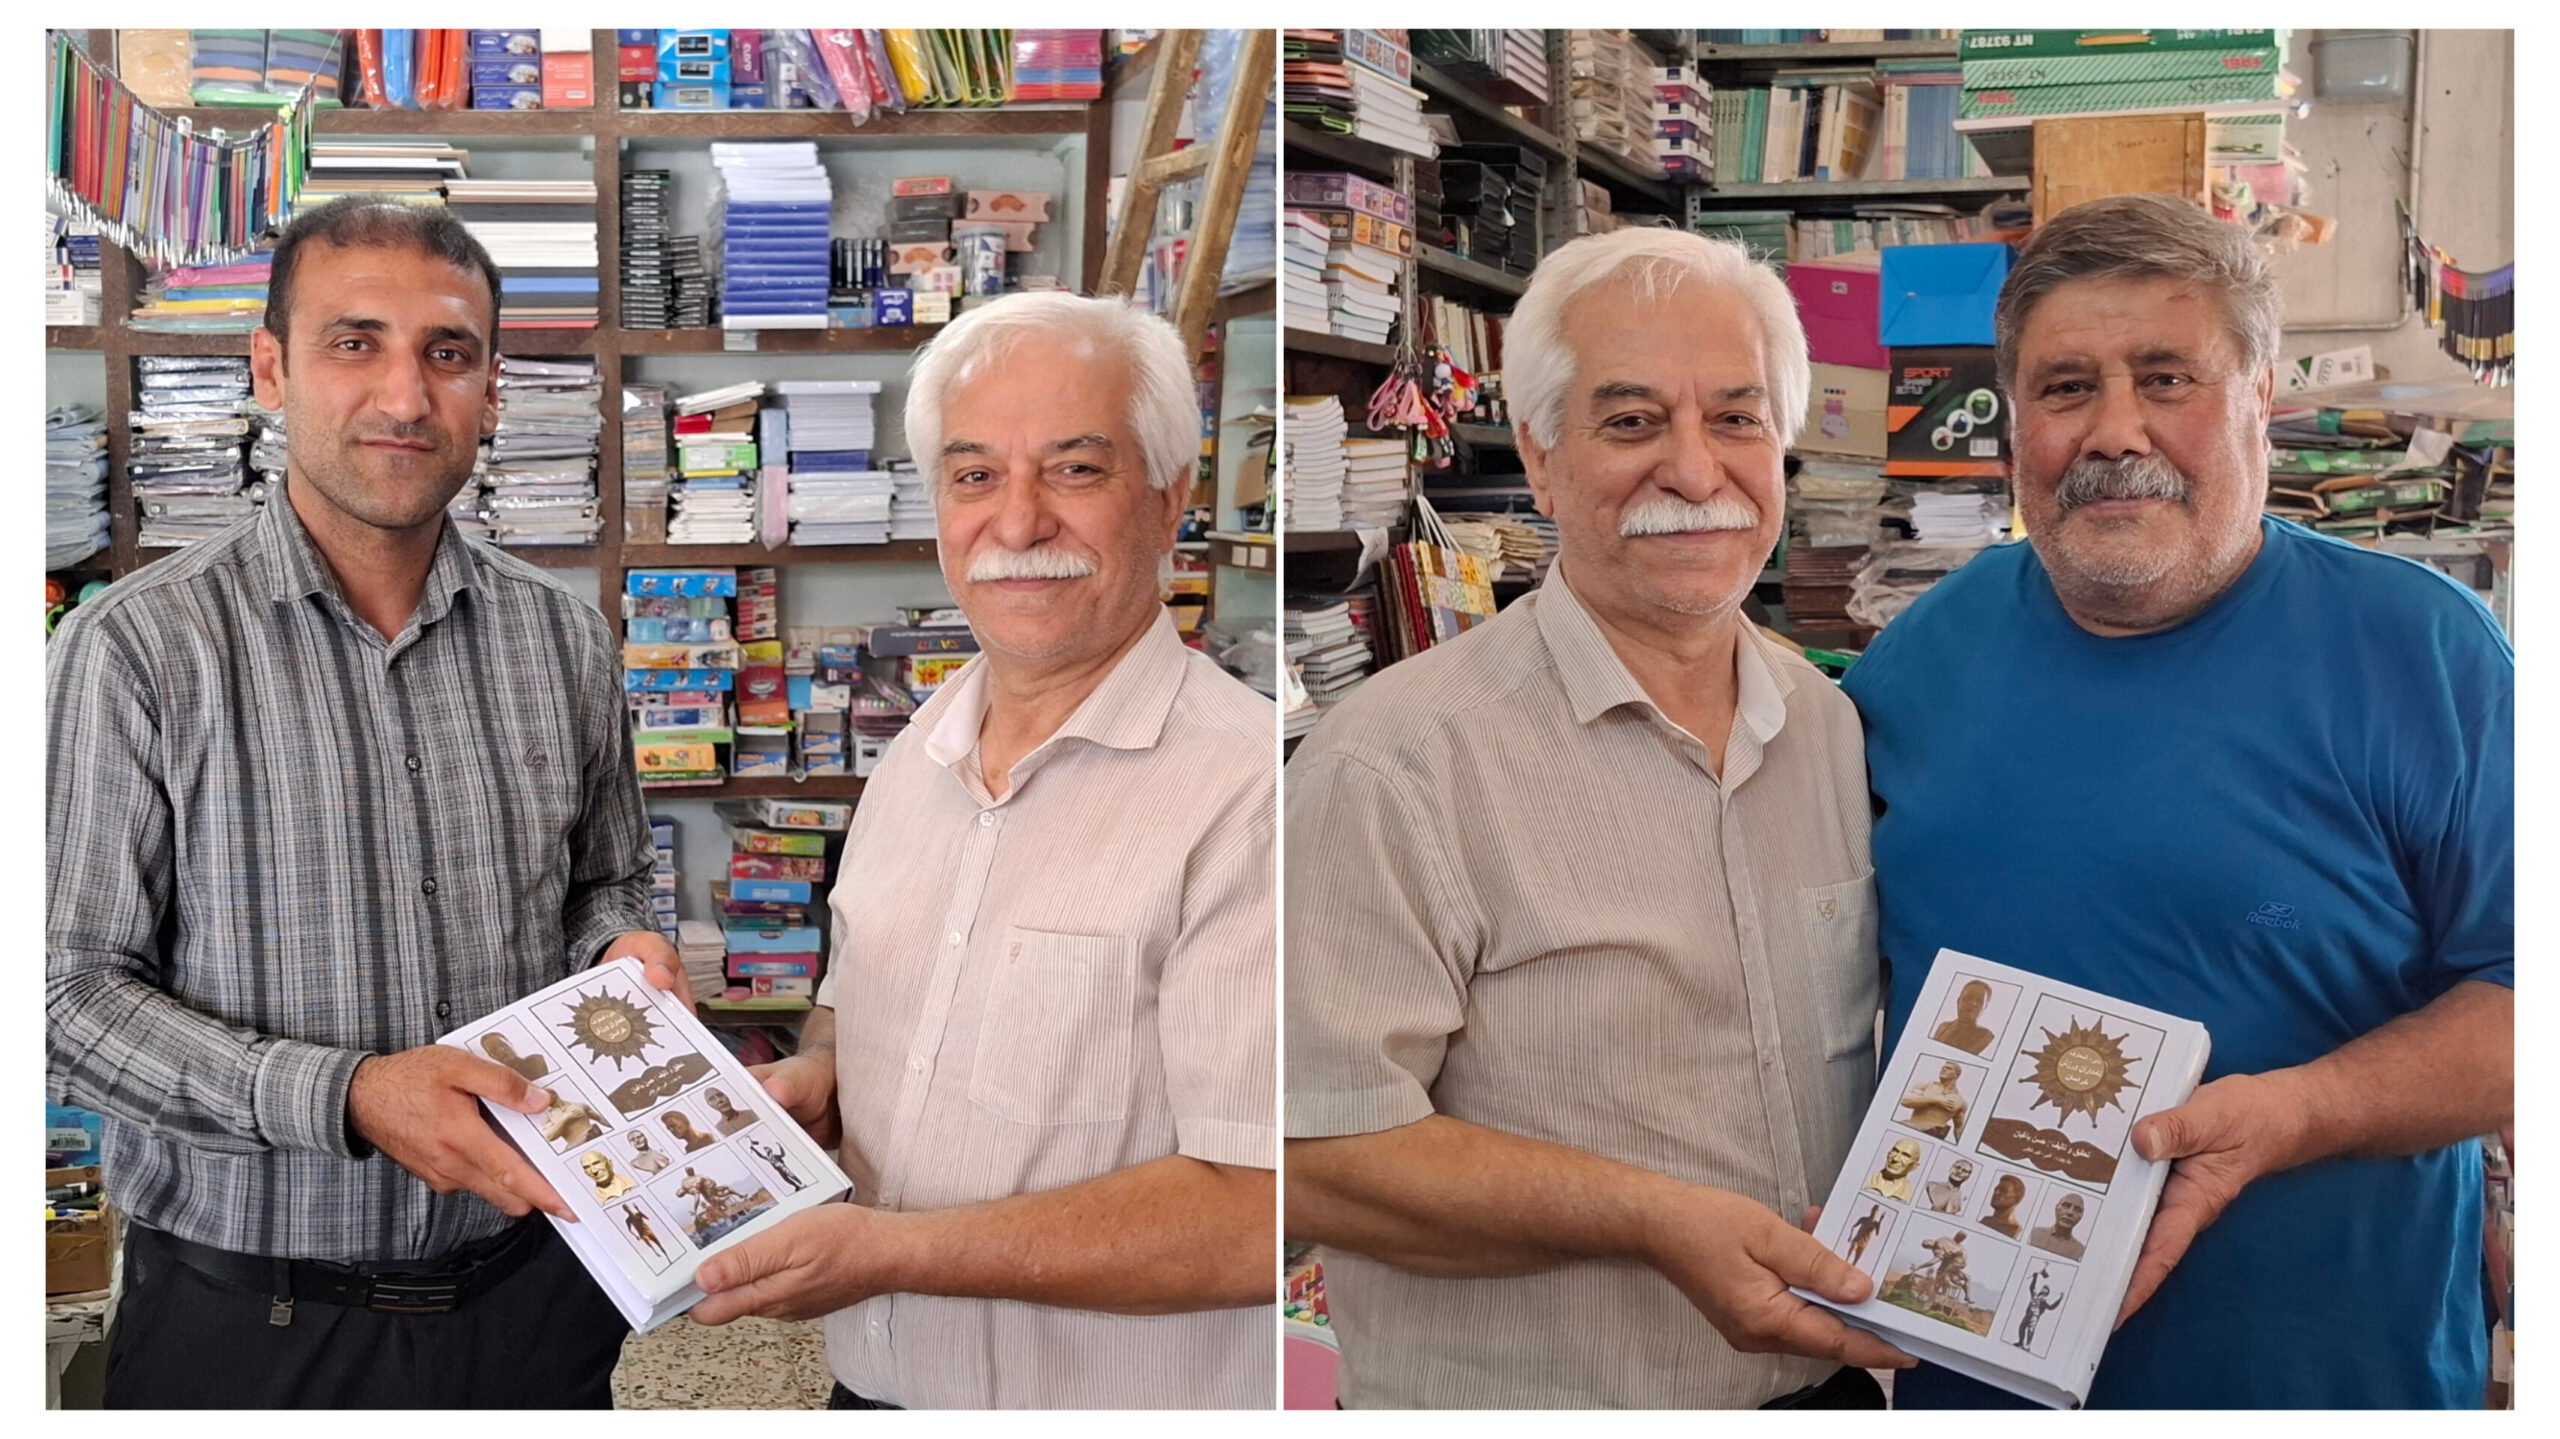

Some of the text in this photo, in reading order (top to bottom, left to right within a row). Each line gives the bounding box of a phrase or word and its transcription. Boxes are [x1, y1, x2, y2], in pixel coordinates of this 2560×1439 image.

[1970, 34, 2034, 48] NT 93787
[1903, 367, 1952, 379] SPORT
[2245, 911, 2299, 930] Reebok
